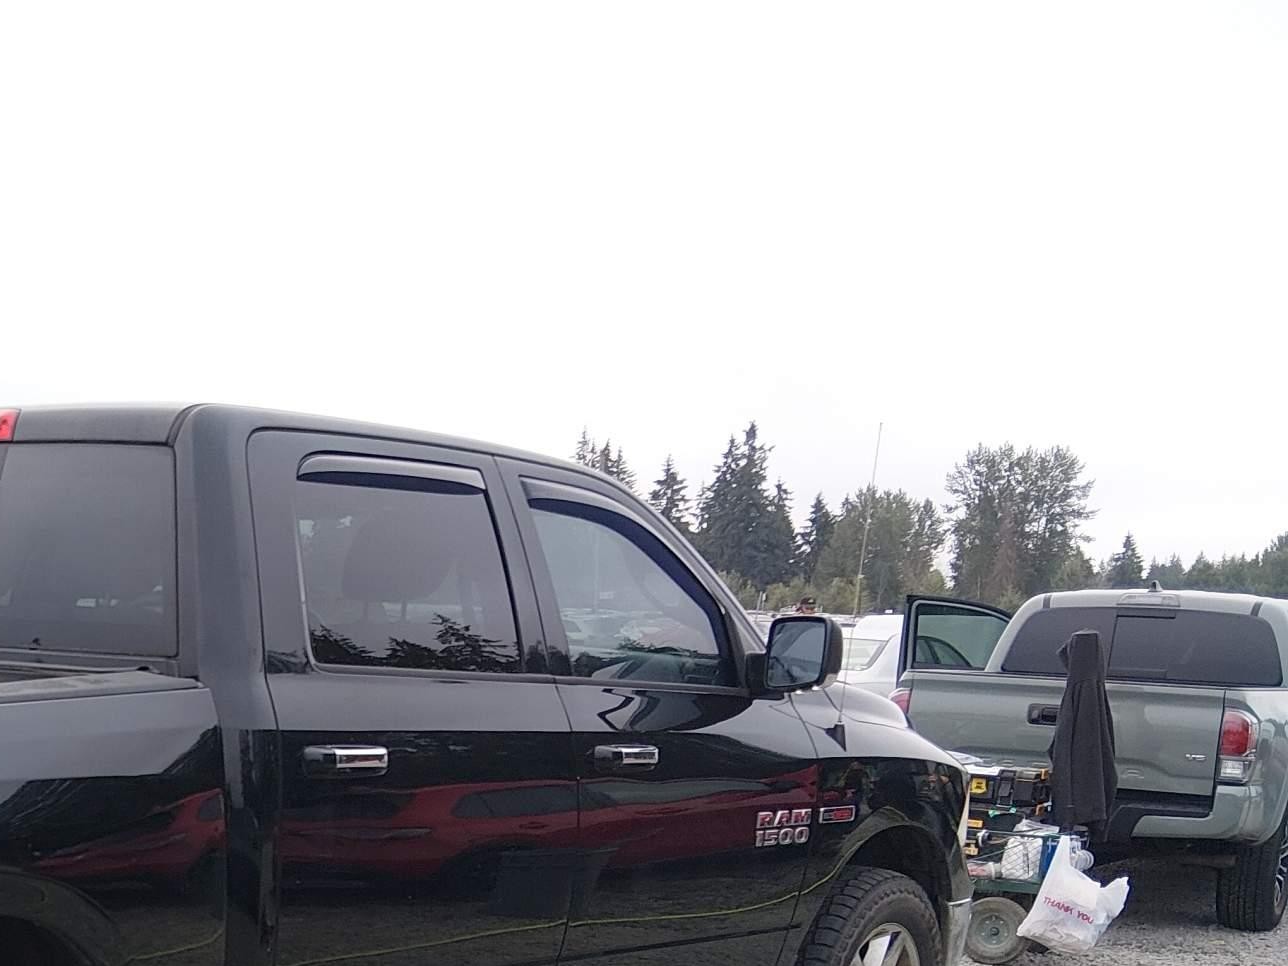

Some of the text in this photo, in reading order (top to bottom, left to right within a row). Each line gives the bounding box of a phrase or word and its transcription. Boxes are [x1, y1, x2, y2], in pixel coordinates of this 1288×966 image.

[756, 808, 813, 829] RAM
[755, 826, 810, 848] 1500
[1043, 896, 1094, 924] THANK YOU
